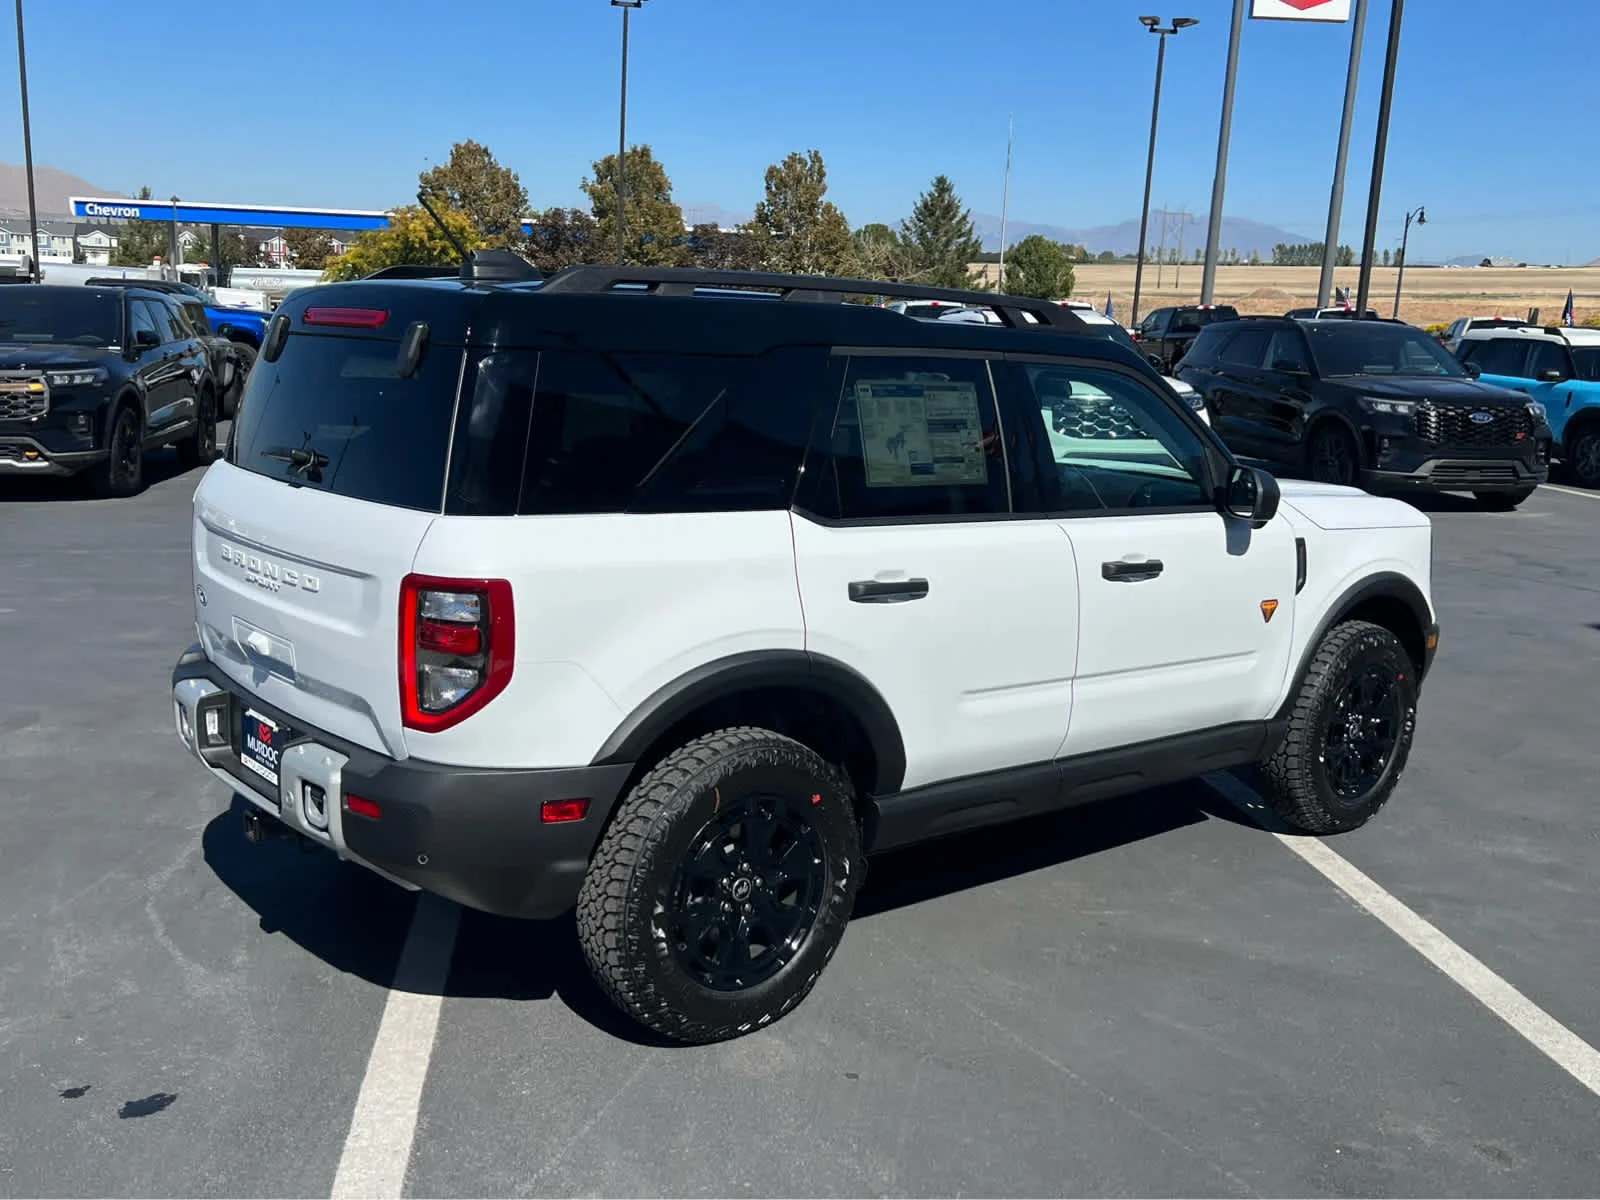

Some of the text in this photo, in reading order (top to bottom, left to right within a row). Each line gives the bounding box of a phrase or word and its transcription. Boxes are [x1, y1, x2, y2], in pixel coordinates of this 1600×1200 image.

[85, 203, 140, 217] Chevron
[221, 543, 320, 594] BRONCO
[246, 733, 279, 765] MURDOC
